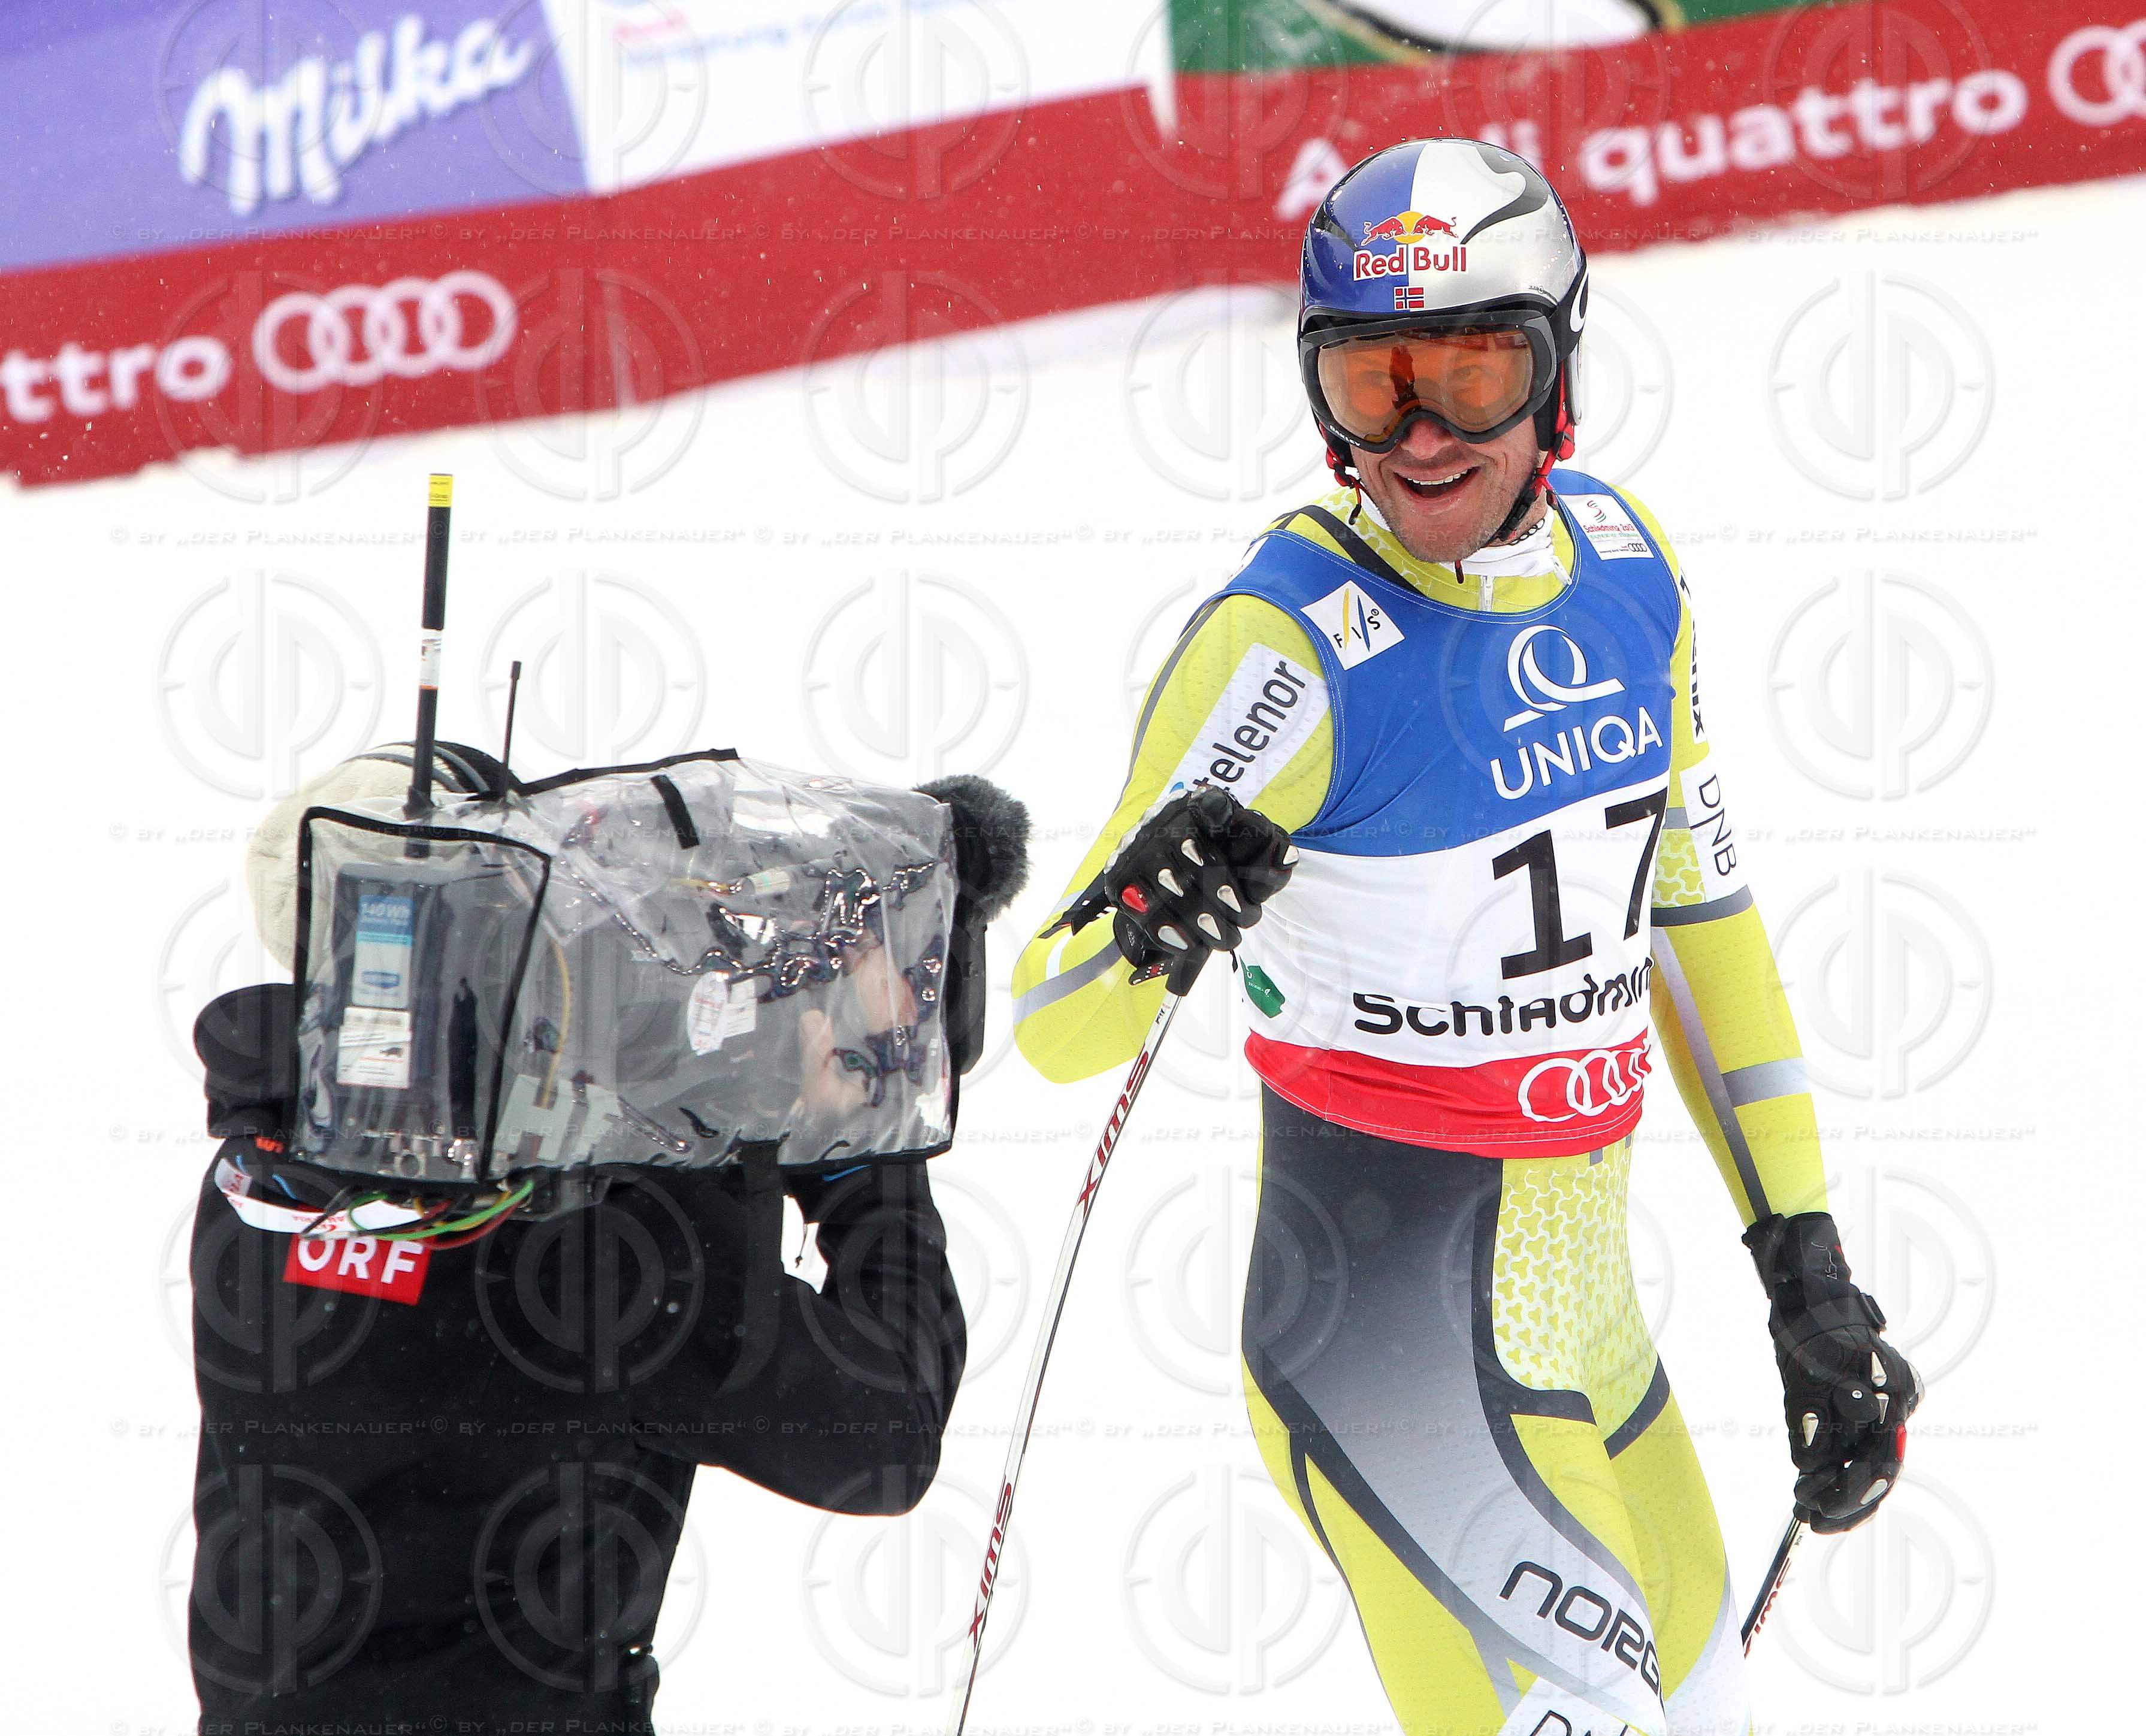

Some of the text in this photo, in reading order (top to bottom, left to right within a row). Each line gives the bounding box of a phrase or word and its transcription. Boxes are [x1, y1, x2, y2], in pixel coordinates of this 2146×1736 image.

[179, 13, 534, 217] Milka
[1580, 67, 2027, 207] quattro
[1355, 244, 1467, 279] Red Bull
[1489, 706, 1664, 800] UNIQA
[1491, 786, 1669, 980] 17
[1690, 773, 1737, 876] DNB
[297, 1235, 424, 1285] ORF
[1499, 1560, 1667, 1718] NORG
